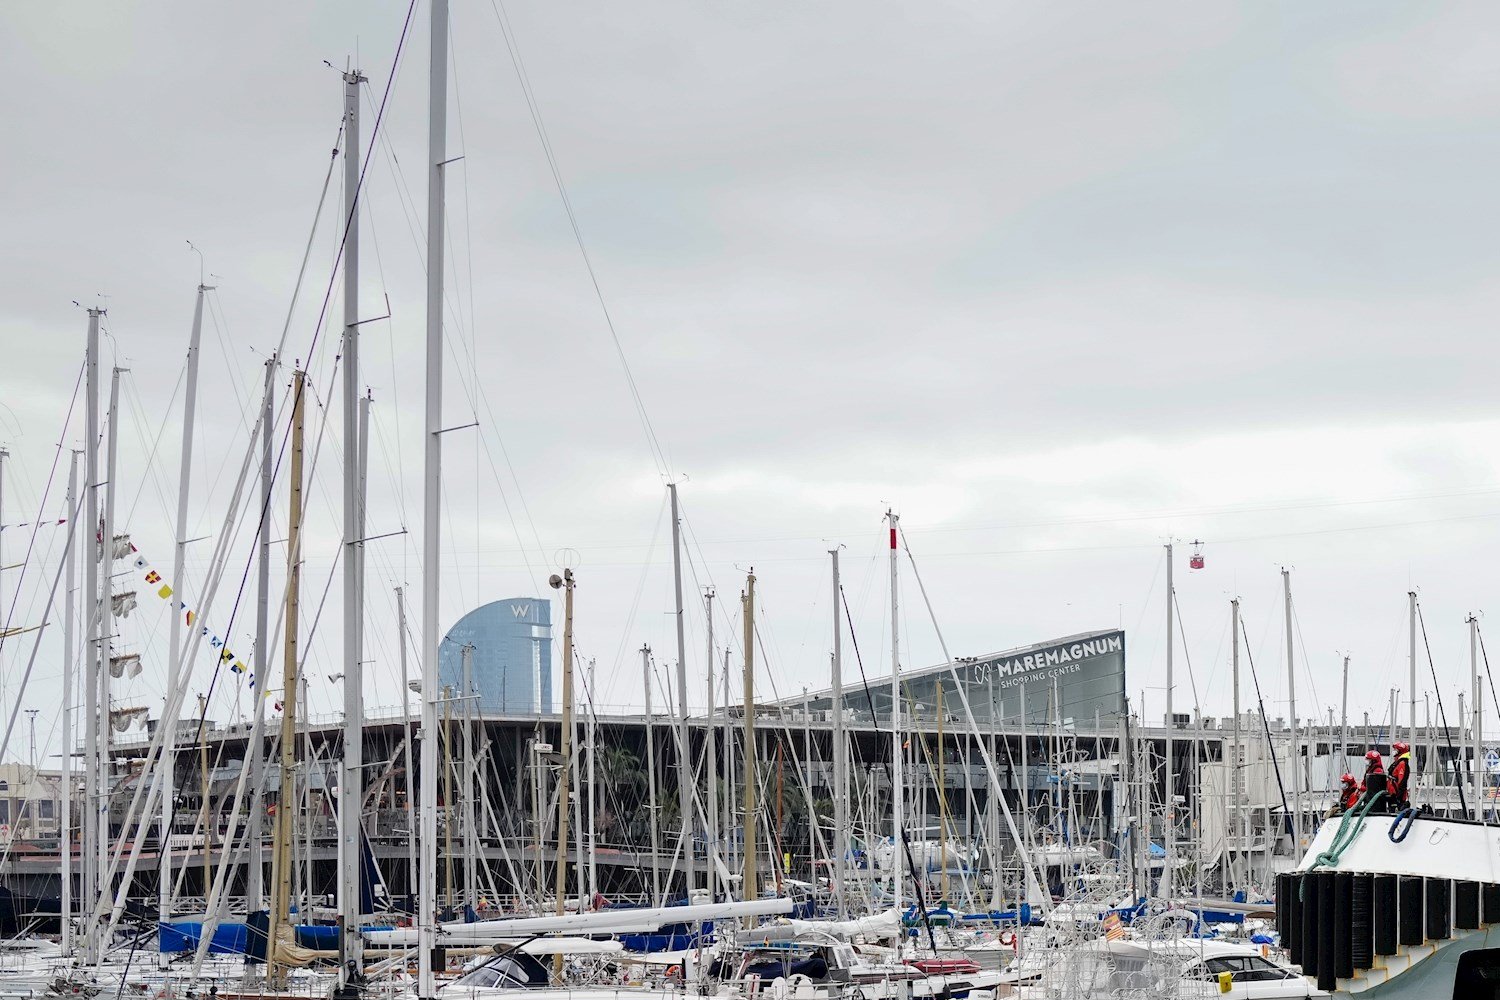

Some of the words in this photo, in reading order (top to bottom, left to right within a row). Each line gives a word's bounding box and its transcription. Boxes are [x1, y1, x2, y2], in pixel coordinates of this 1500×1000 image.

[511, 604, 530, 618] W
[997, 635, 1122, 678] MAREMAGNUM
[1001, 671, 1046, 689] SHOPPING
[1049, 663, 1081, 678] CENTER
